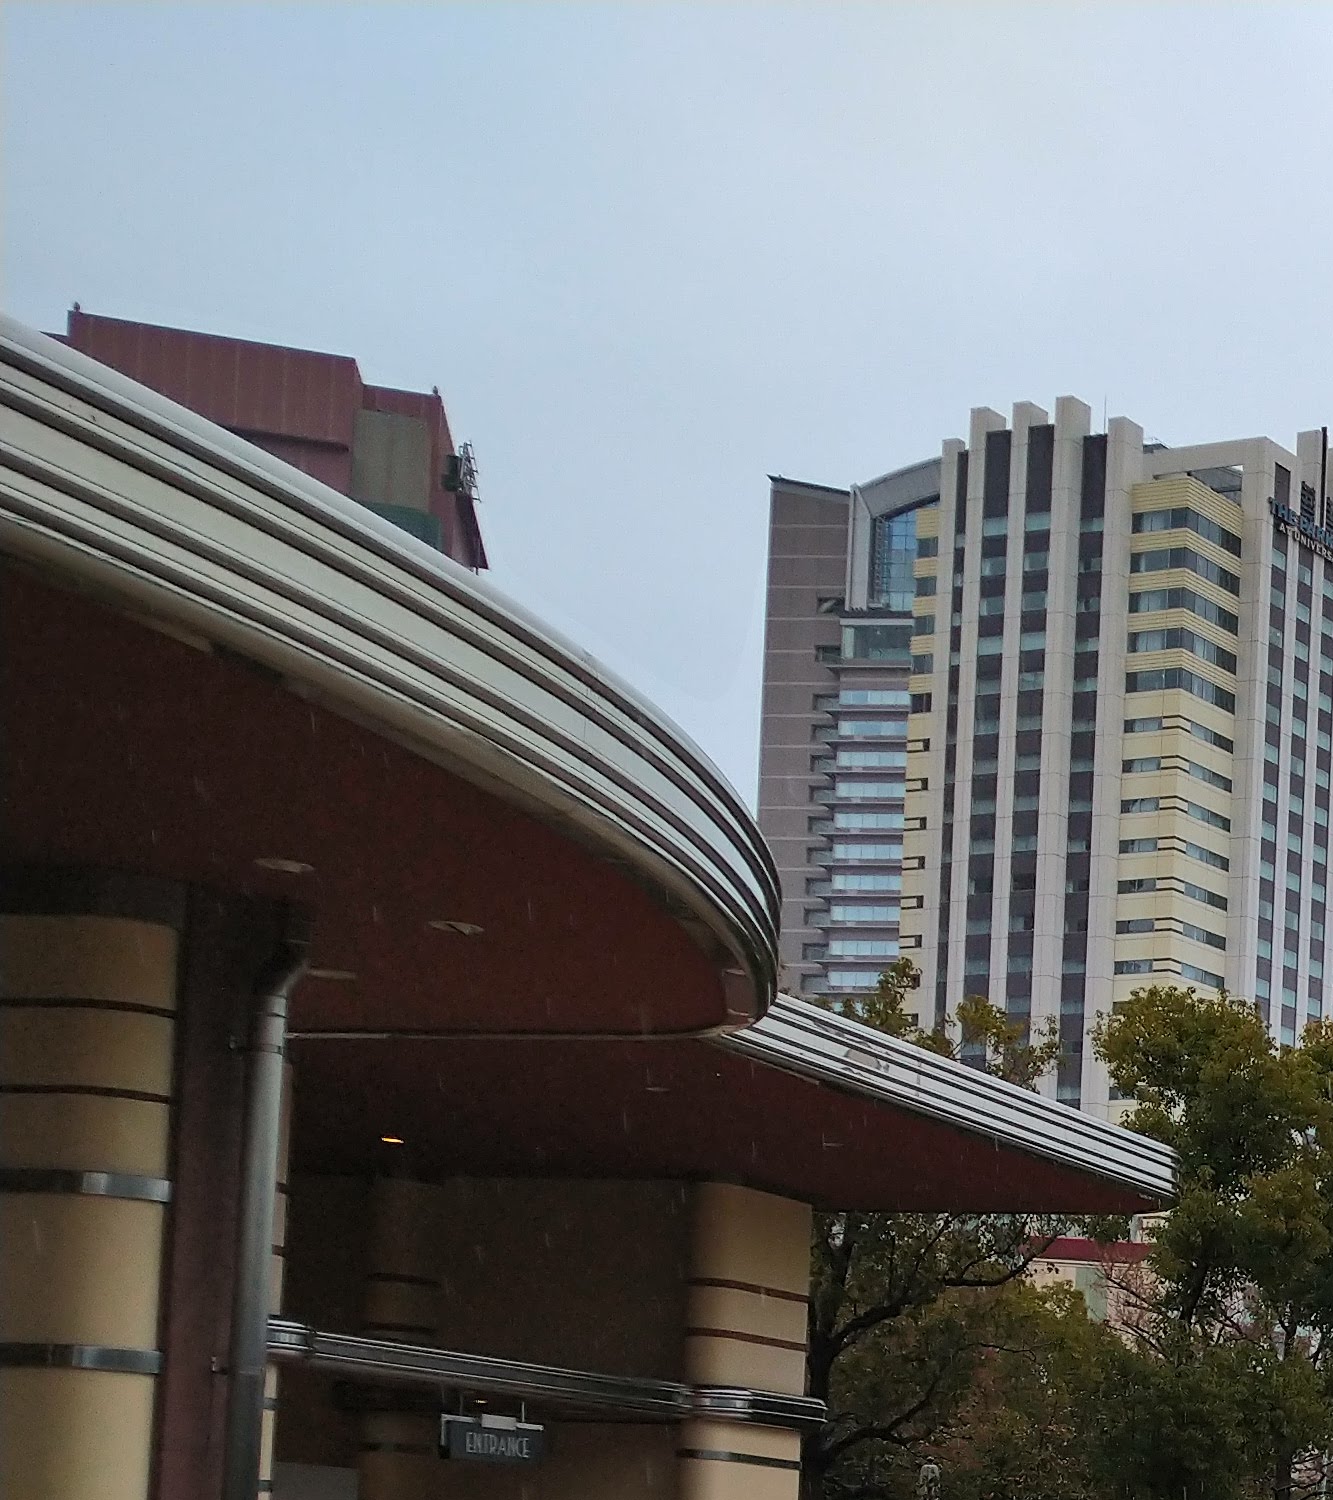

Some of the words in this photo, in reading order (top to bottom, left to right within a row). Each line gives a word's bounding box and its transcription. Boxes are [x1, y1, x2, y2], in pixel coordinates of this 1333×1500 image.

[1268, 498, 1299, 524] THE
[1279, 523, 1292, 537] AT
[465, 1431, 530, 1458] ENTRANCE
